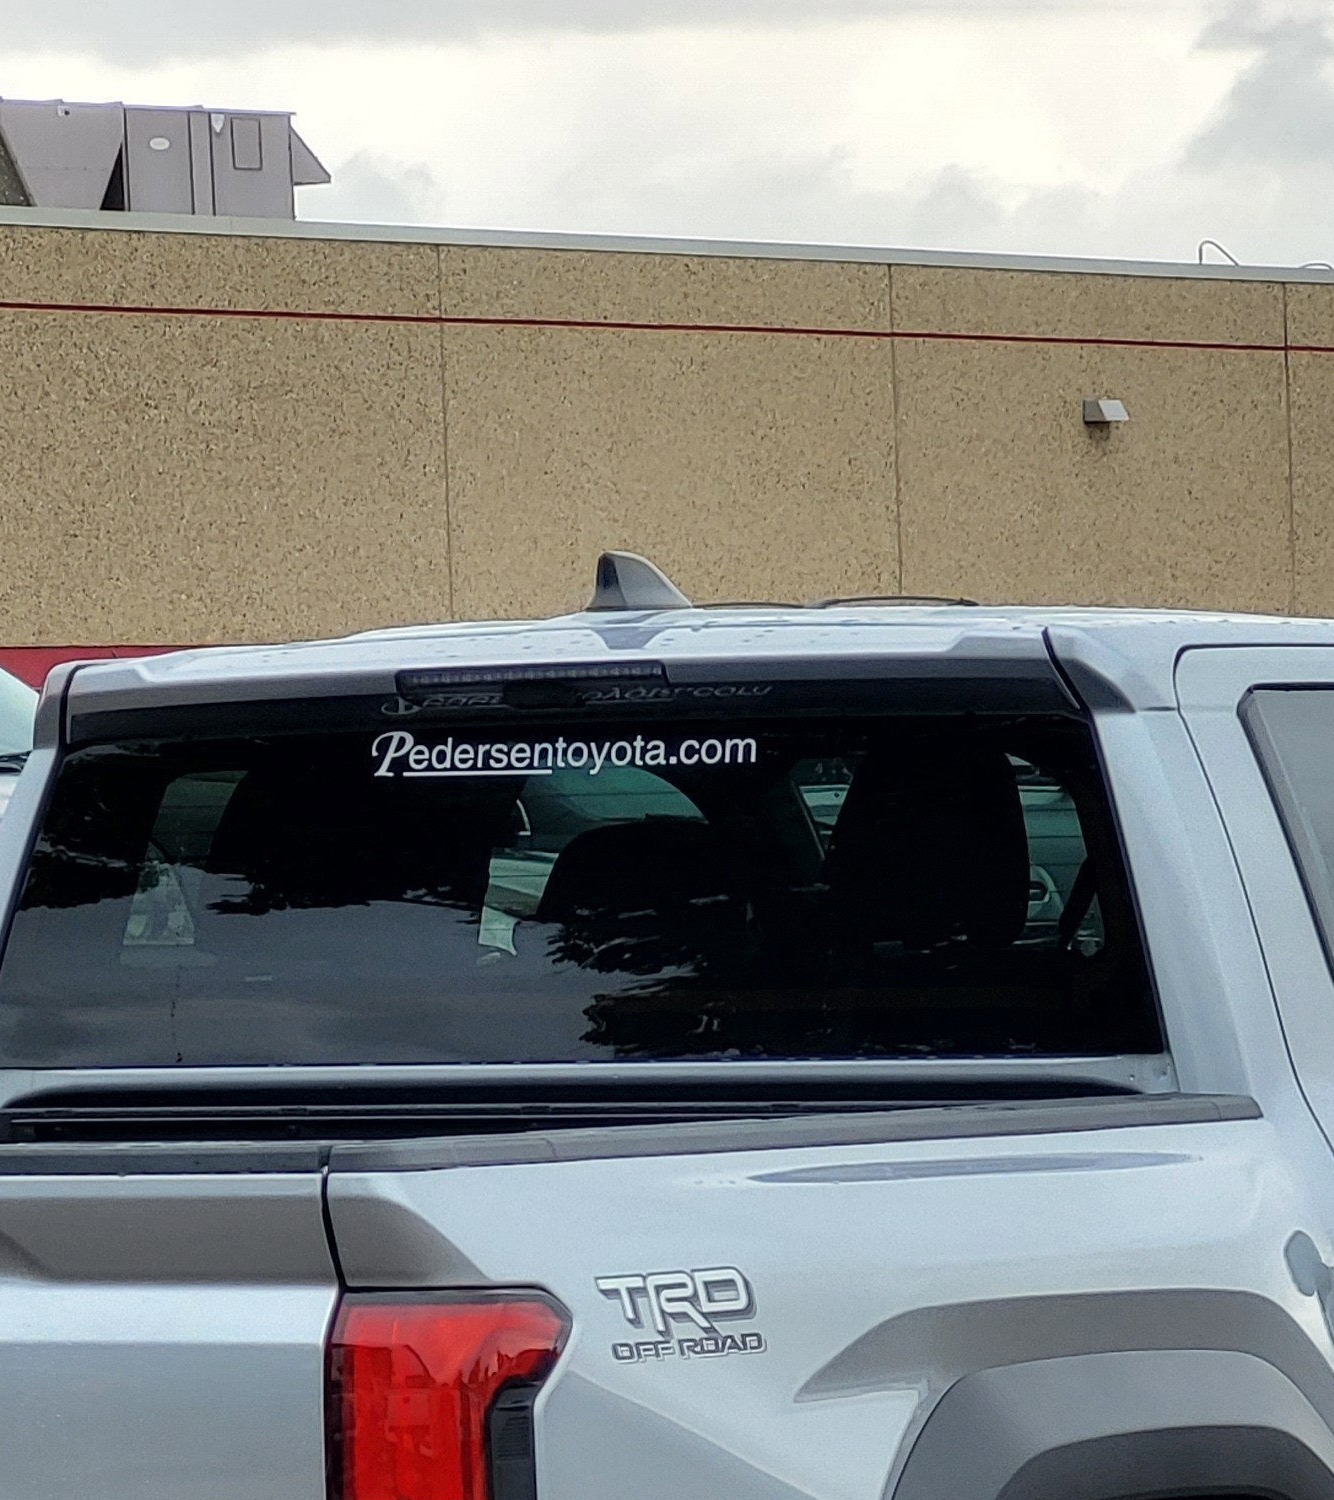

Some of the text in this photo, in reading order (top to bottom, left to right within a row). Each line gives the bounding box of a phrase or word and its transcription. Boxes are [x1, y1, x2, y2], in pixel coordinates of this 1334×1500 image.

[372, 731, 757, 776] Pedersentoyota.com
[594, 1266, 757, 1338] TRD
[611, 1332, 766, 1364] OFF ROAD
